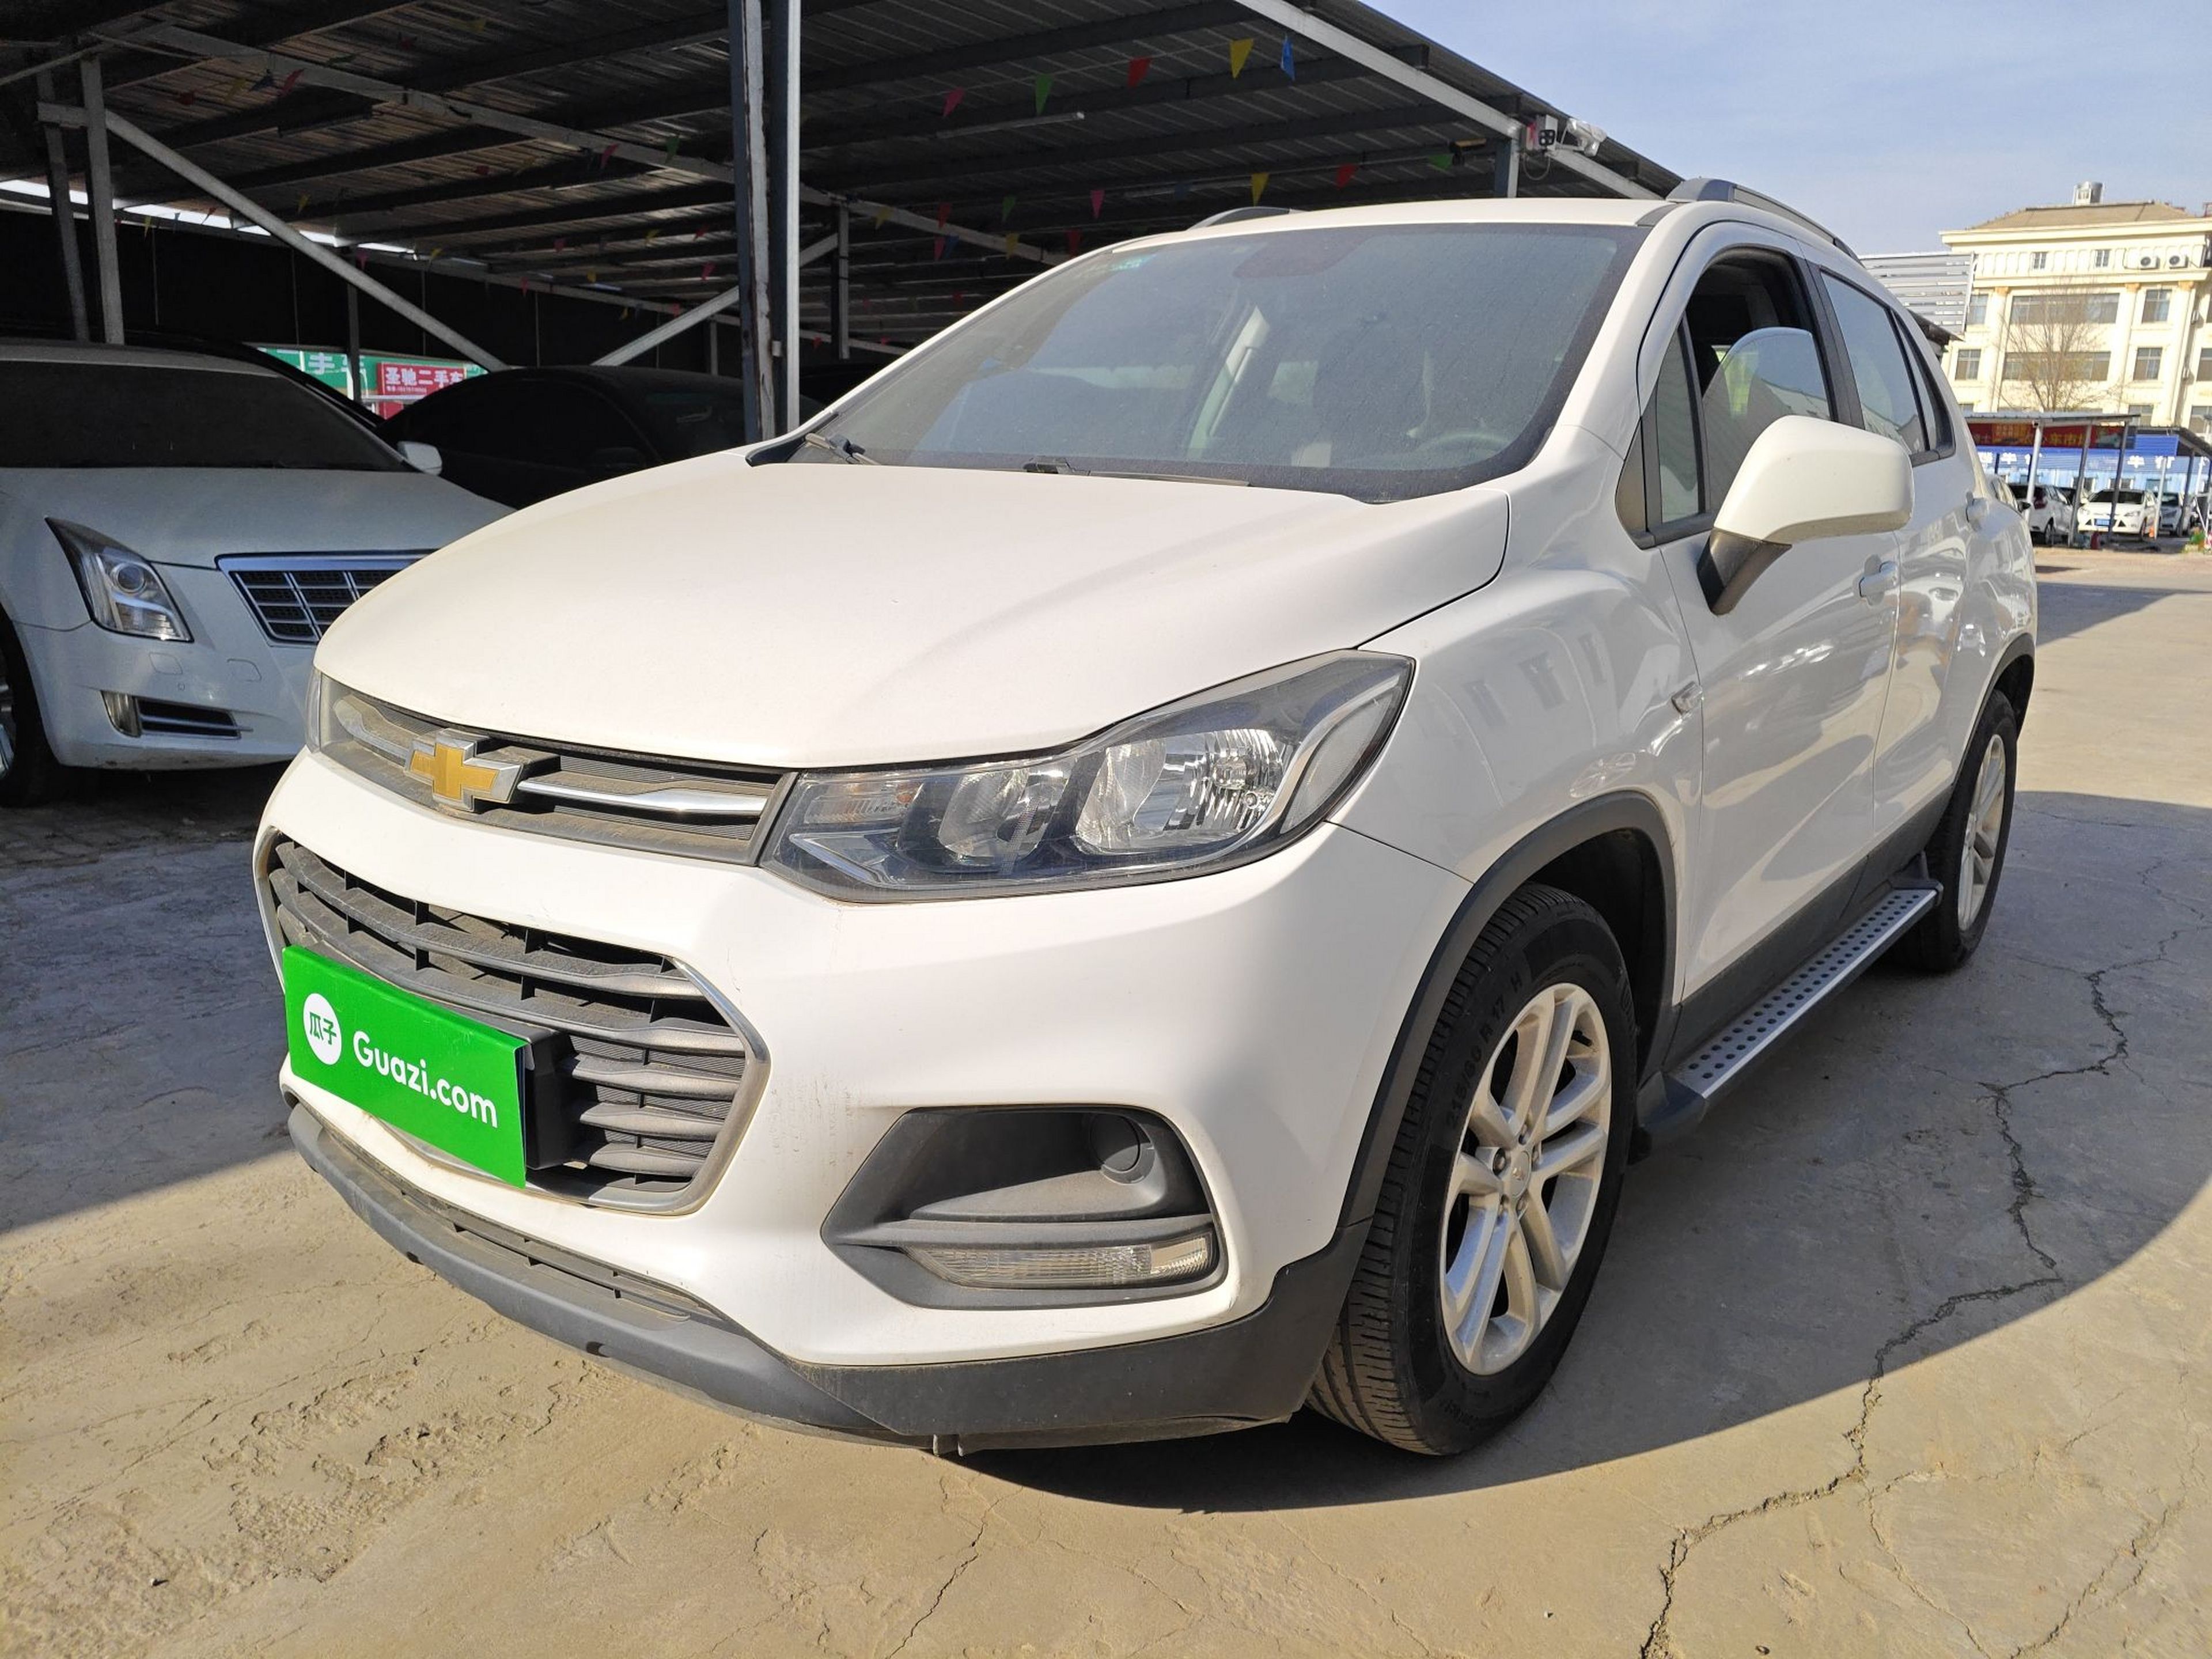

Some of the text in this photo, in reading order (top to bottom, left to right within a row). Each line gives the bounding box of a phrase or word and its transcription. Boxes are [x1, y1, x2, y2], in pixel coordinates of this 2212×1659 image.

[385, 366, 464, 389] 圣驰二手车
[309, 1012, 498, 1128] 瓜子 Guazi.com
